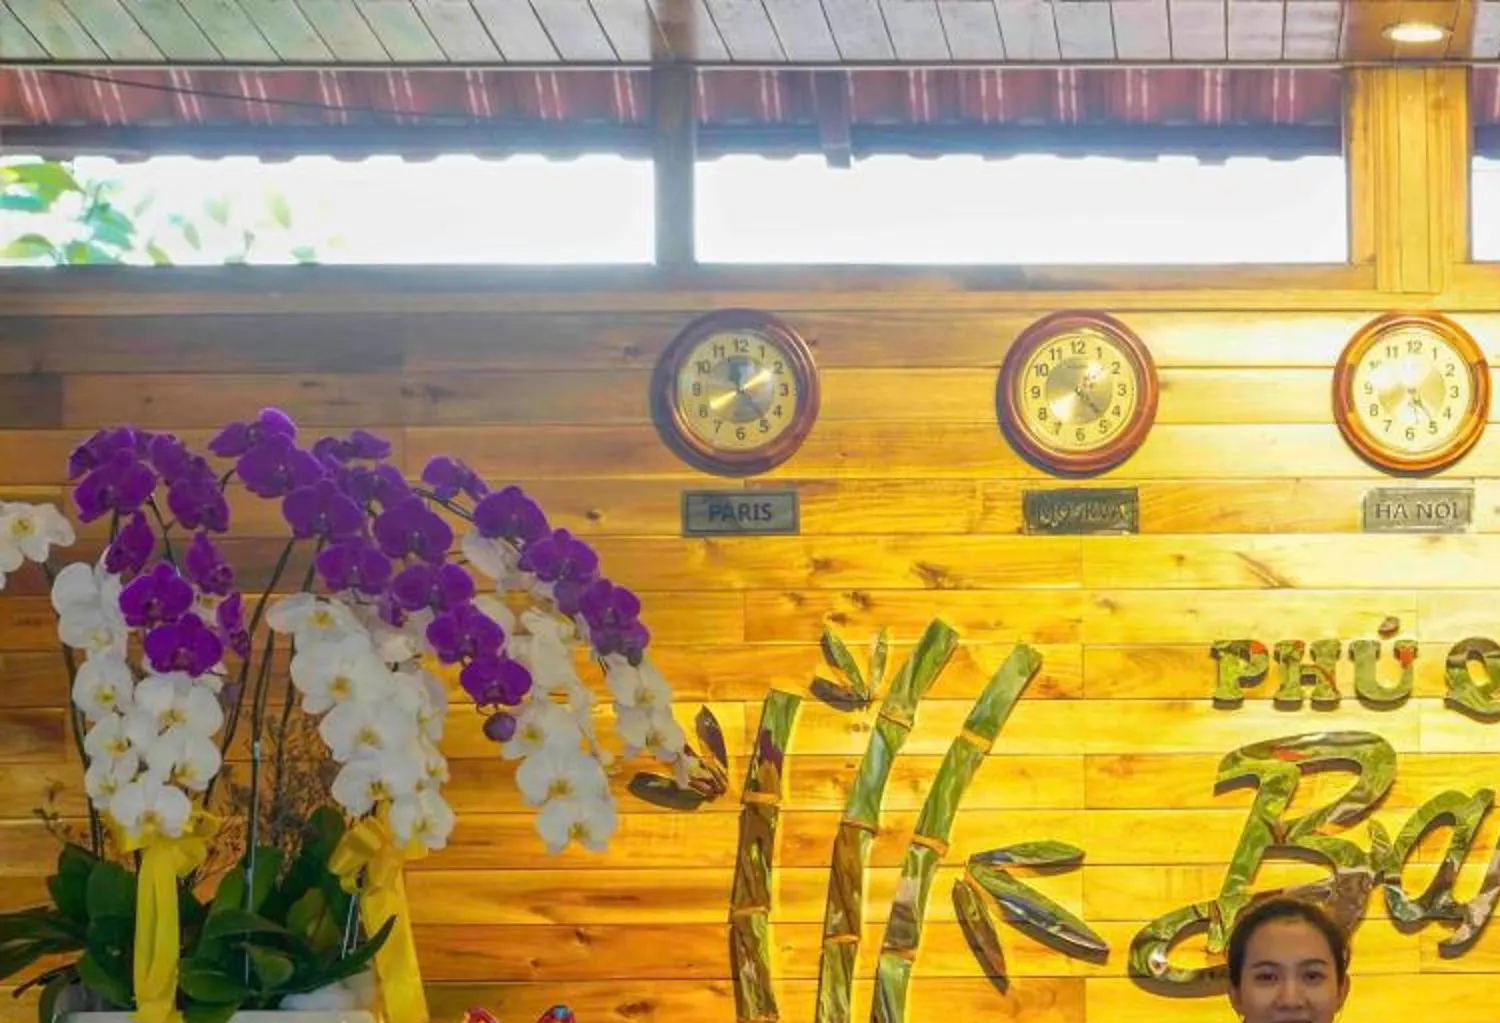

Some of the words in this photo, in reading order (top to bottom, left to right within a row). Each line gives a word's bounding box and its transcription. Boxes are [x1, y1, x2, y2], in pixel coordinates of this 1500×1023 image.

[712, 344, 726, 358] 11
[733, 338, 750, 353] 12
[1070, 340, 1086, 355] 12
[1385, 345, 1399, 359] 11
[1405, 339, 1423, 354] 12
[1049, 347, 1063, 361] 11
[695, 359, 712, 375] 10
[773, 360, 785, 375] 2
[1034, 363, 1049, 377] 10
[1110, 361, 1121, 375] 2
[1444, 362, 1456, 377] 2
[779, 382, 790, 398] 3
[1030, 385, 1041, 399] 9
[1117, 383, 1127, 397] 3
[1449, 385, 1460, 399] 3
[771, 403, 783, 418] 4
[1037, 407, 1048, 421] 8
[1111, 404, 1121, 418] 4
[1369, 403, 1379, 417] 8
[1442, 406, 1452, 420] 4
[713, 419, 723, 434] 7
[735, 426, 746, 441] 6
[759, 419, 769, 434] 5
[1053, 420, 1063, 436] 7
[1098, 419, 1109, 434] 5
[1382, 419, 1393, 433] 7
[1428, 420, 1439, 435] 5
[1075, 427, 1086, 441] 6
[1404, 427, 1415, 441] 6
[707, 502, 773, 523] PARIS
[1375, 502, 1409, 519] HA
[1416, 501, 1459, 519] NOI
